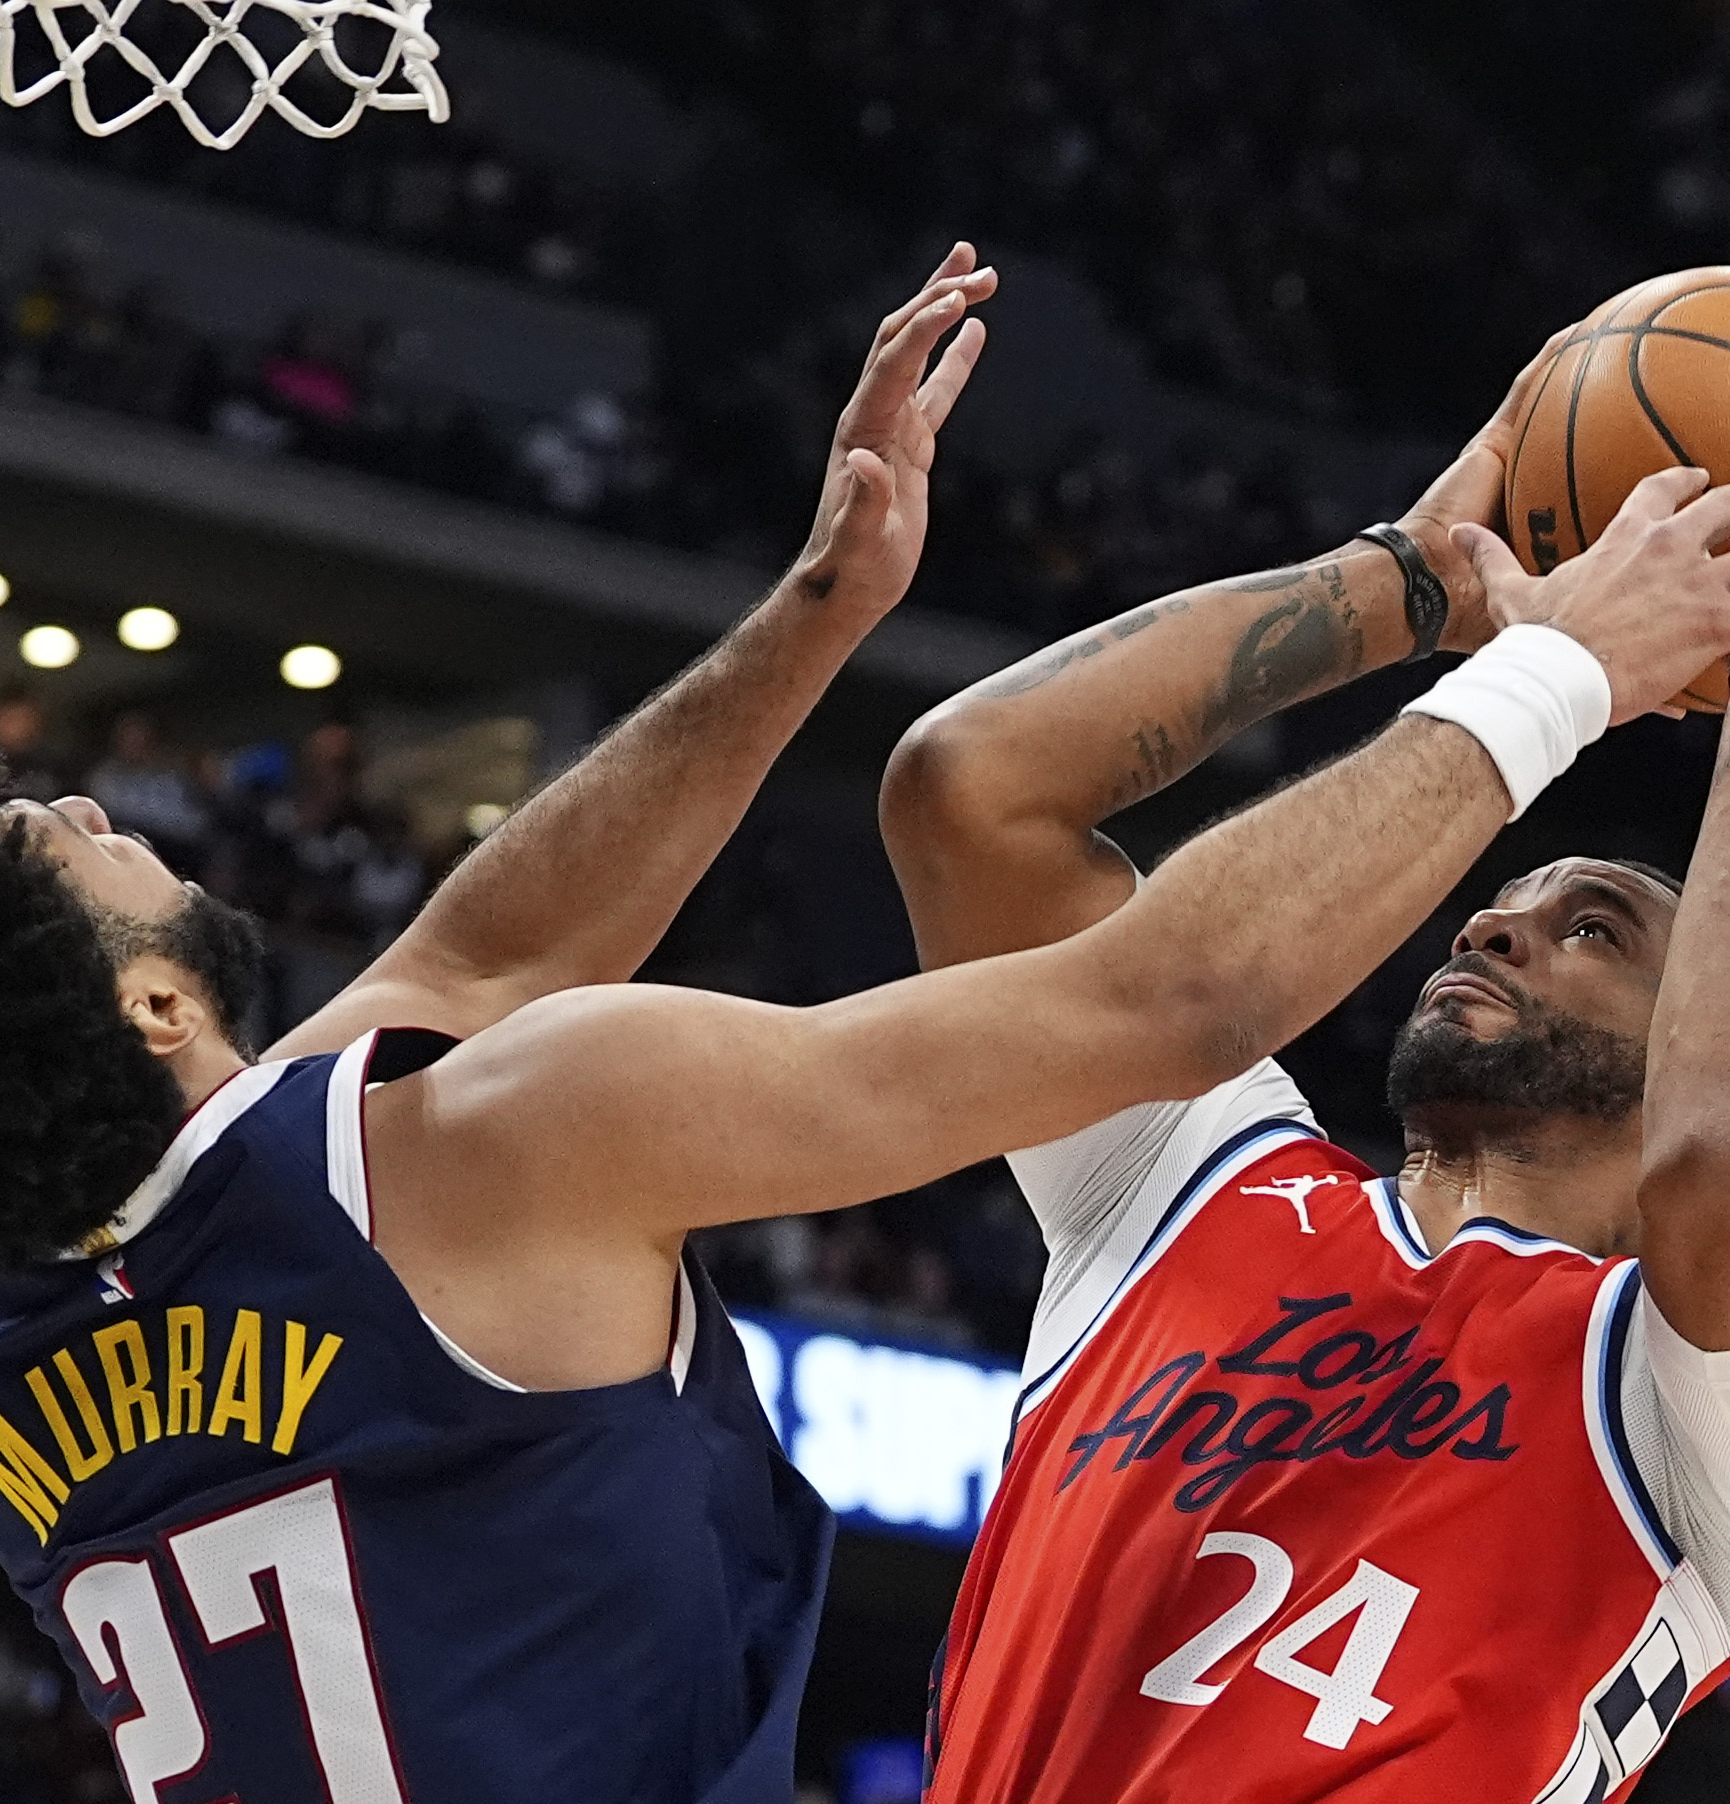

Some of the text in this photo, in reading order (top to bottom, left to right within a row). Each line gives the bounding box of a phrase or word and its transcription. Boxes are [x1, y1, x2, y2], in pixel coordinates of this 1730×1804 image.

[1215, 1292, 1422, 1391] Los
[1055, 1350, 1521, 1514] Angeles
[1139, 1531, 1420, 1750] 24
